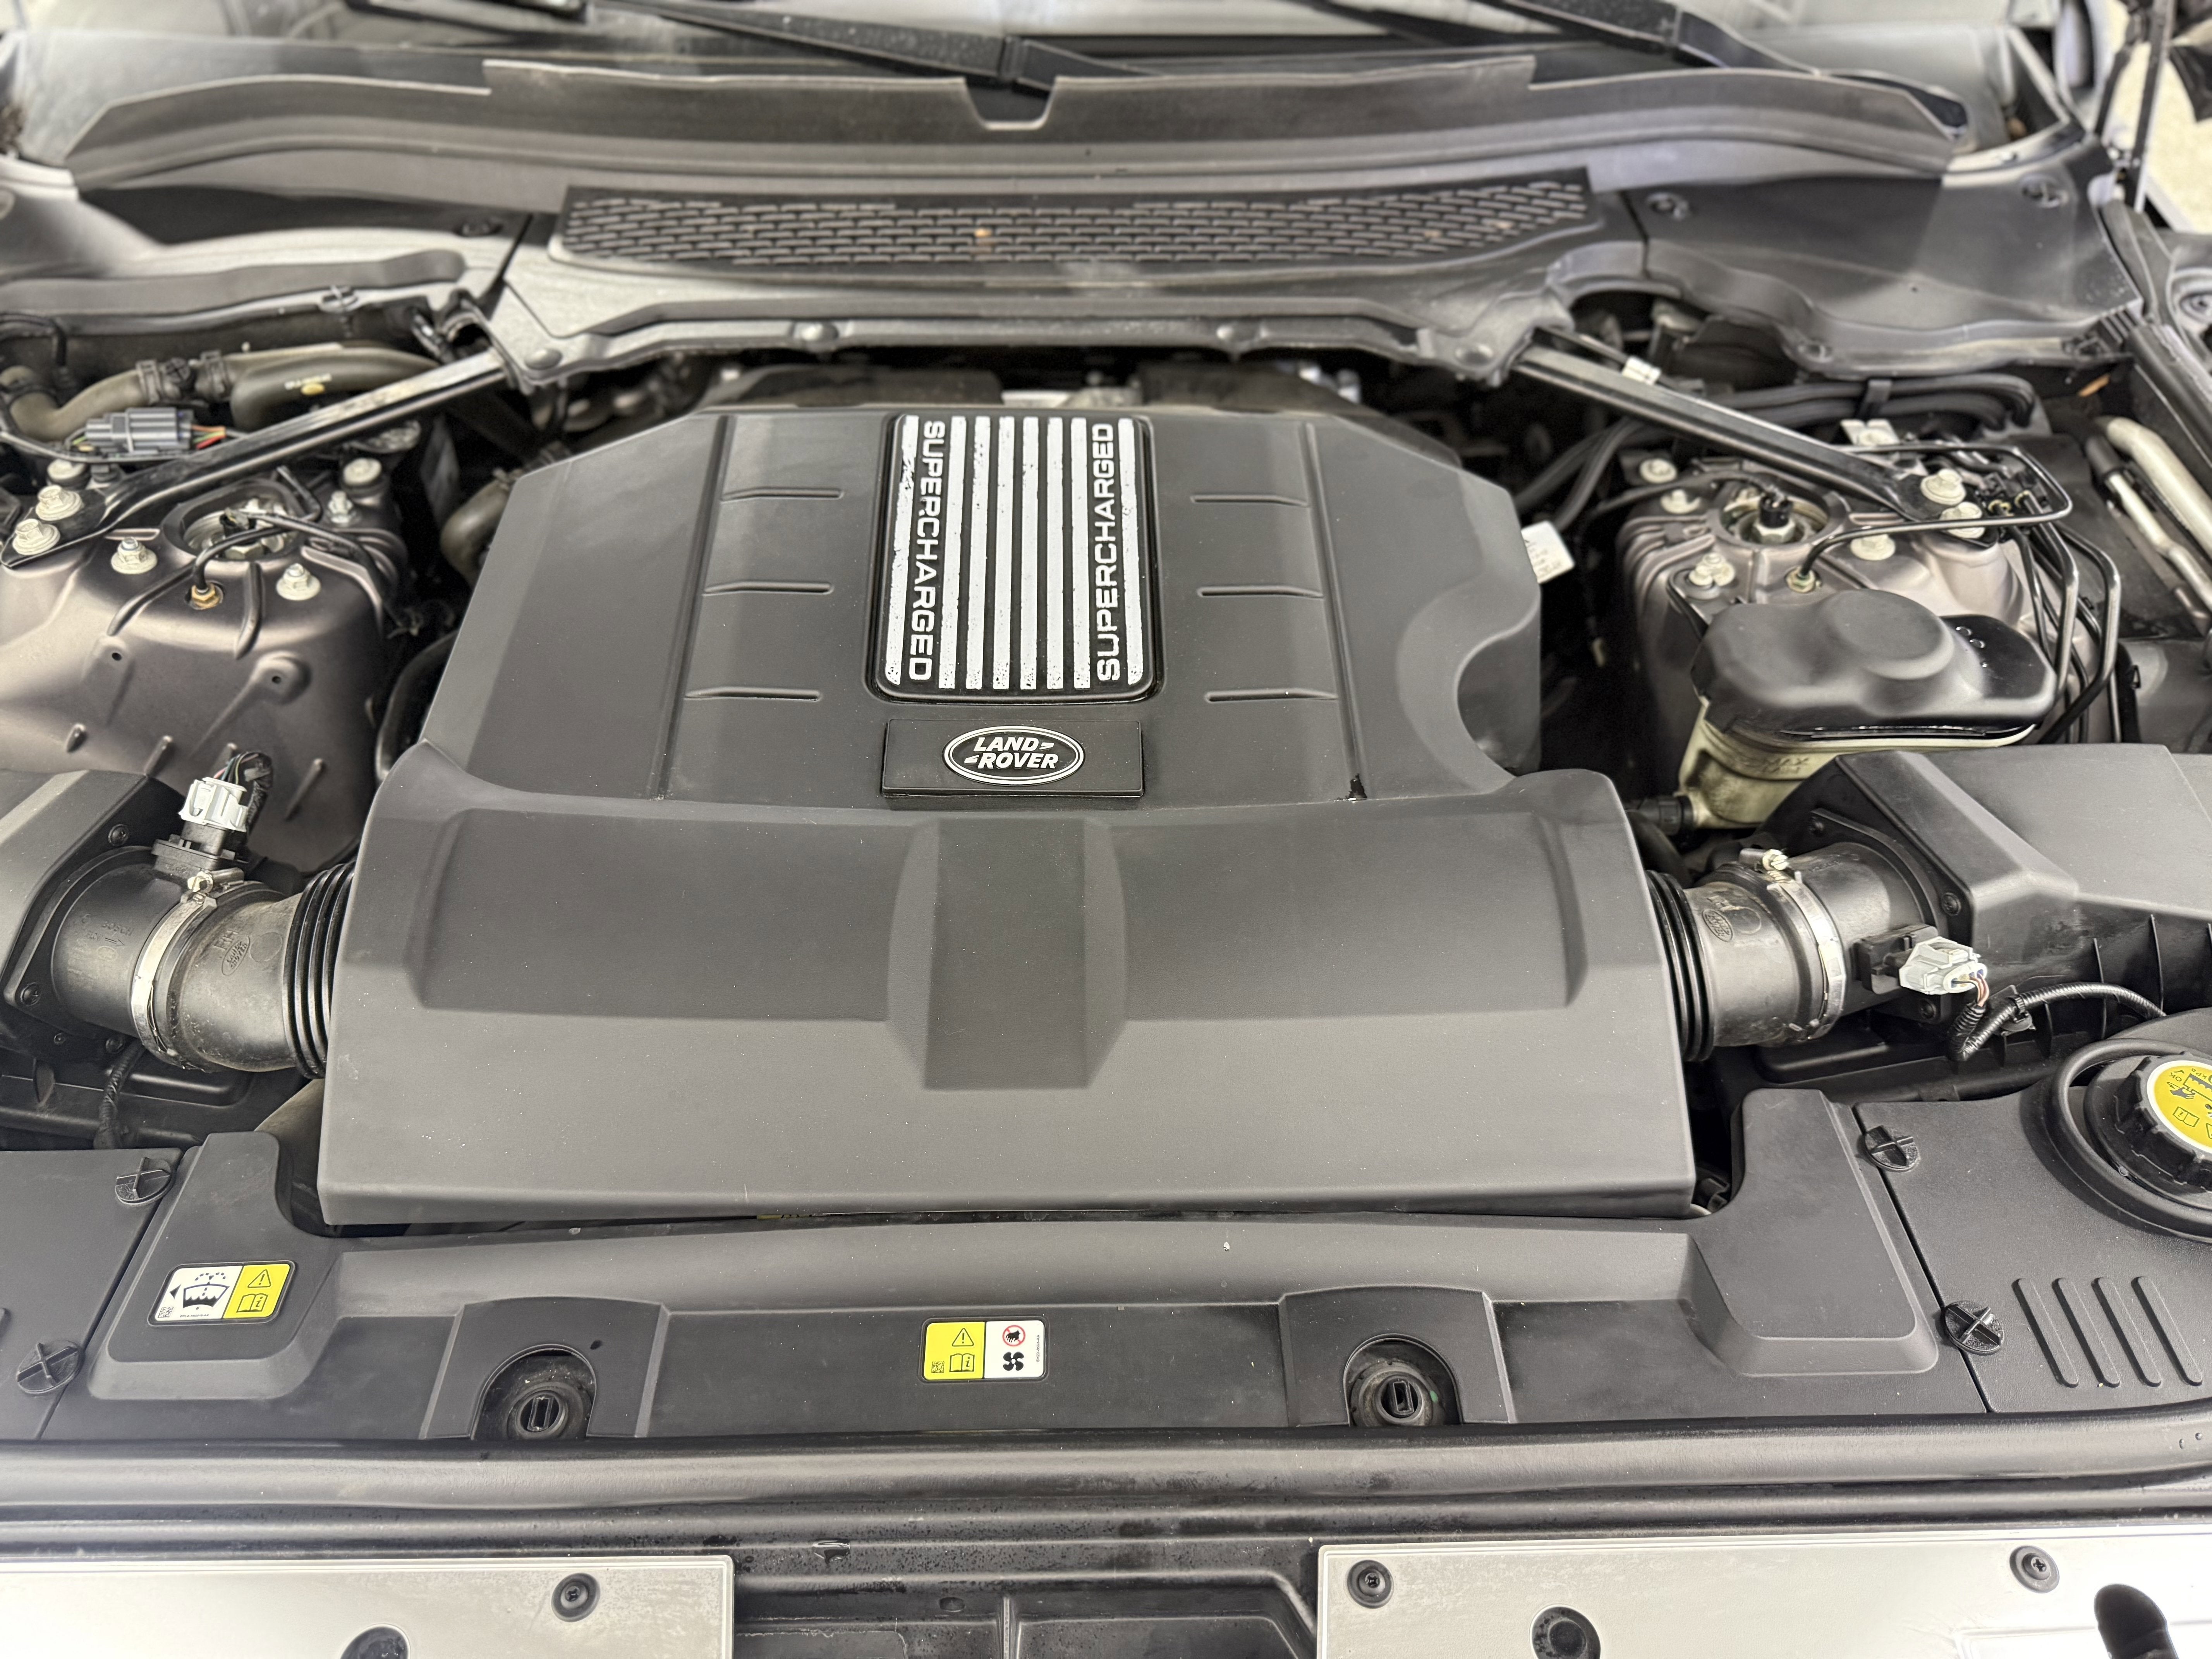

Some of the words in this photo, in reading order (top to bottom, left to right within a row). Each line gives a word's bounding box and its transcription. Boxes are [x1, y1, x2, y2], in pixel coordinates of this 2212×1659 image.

[909, 420, 946, 680] SUPERCHARGED
[1092, 422, 1120, 682] SUPERCHARGED
[974, 737, 1039, 752] LAND
[978, 752, 1059, 769] ROVER
[213, 929, 238, 950] RH
[2169, 1072, 2182, 1082] OK
[2191, 1068, 2207, 1079] kPa
